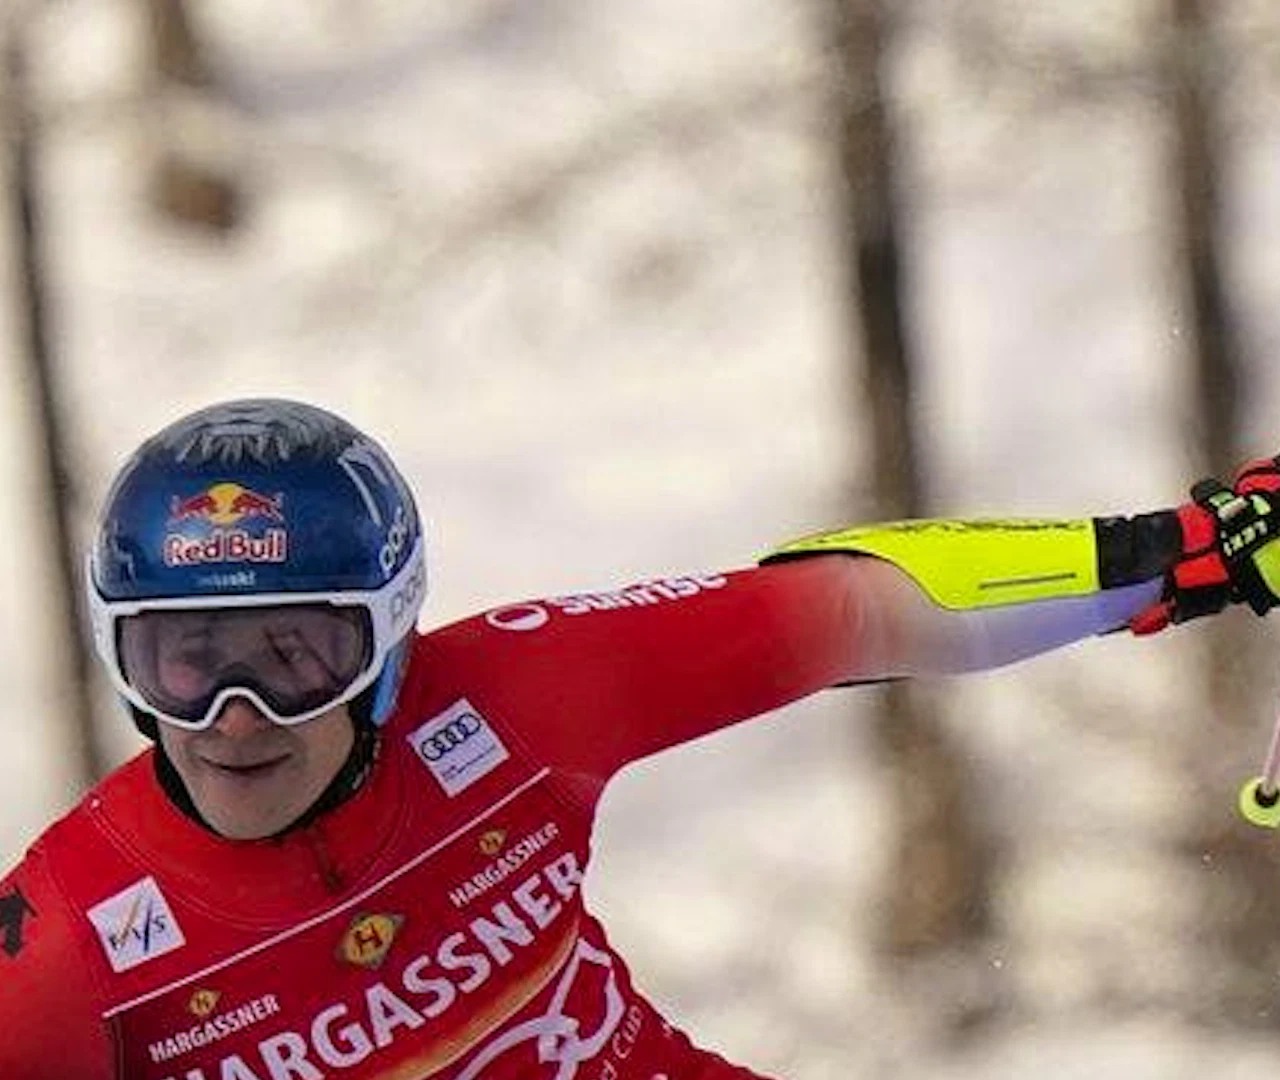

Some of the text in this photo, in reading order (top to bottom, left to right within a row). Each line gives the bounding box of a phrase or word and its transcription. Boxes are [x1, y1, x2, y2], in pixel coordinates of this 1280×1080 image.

[165, 525, 286, 567] Red Bull
[148, 994, 281, 1063] HARGASSNER
